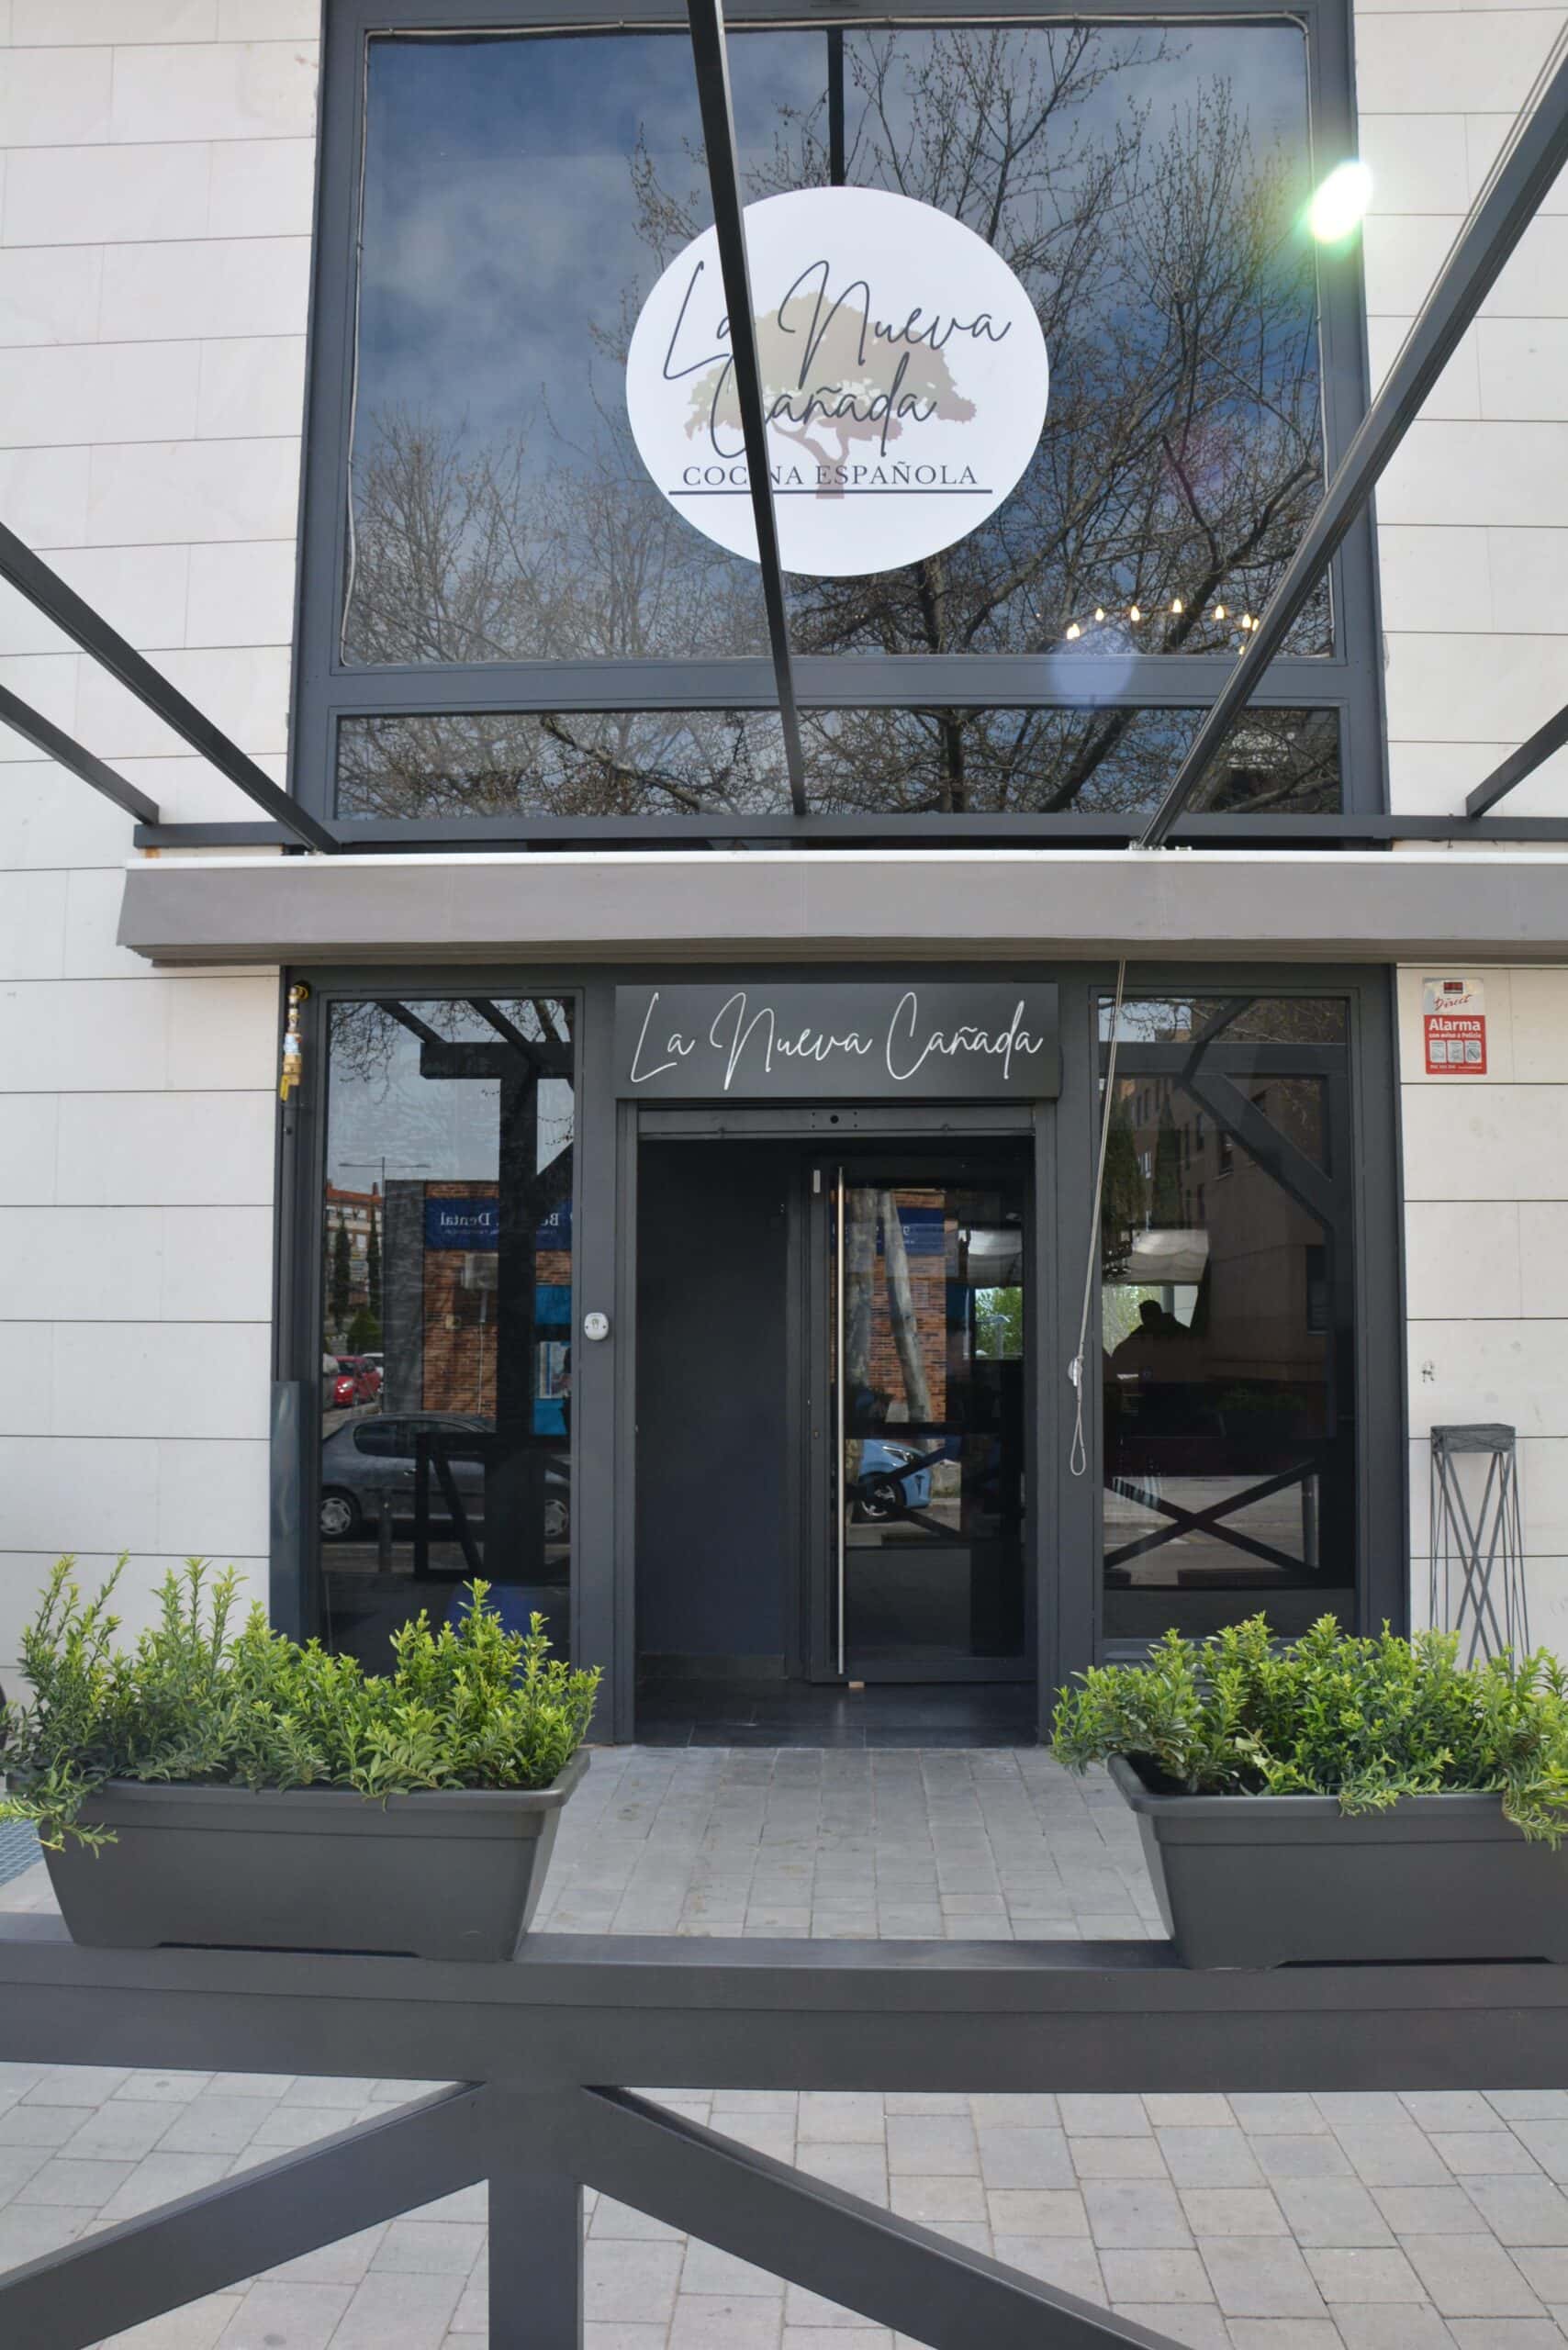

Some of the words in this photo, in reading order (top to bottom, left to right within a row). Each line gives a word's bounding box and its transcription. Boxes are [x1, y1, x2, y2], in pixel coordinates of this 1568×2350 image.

[778, 260, 1012, 390] Nueva
[682, 464, 804, 486] COCNA
[815, 461, 979, 486] ESPAÑOLA
[631, 991, 695, 1082] La
[710, 991, 873, 1091] Nueva
[886, 991, 1044, 1080] Cañada
[1428, 1017, 1481, 1031] Alarma
